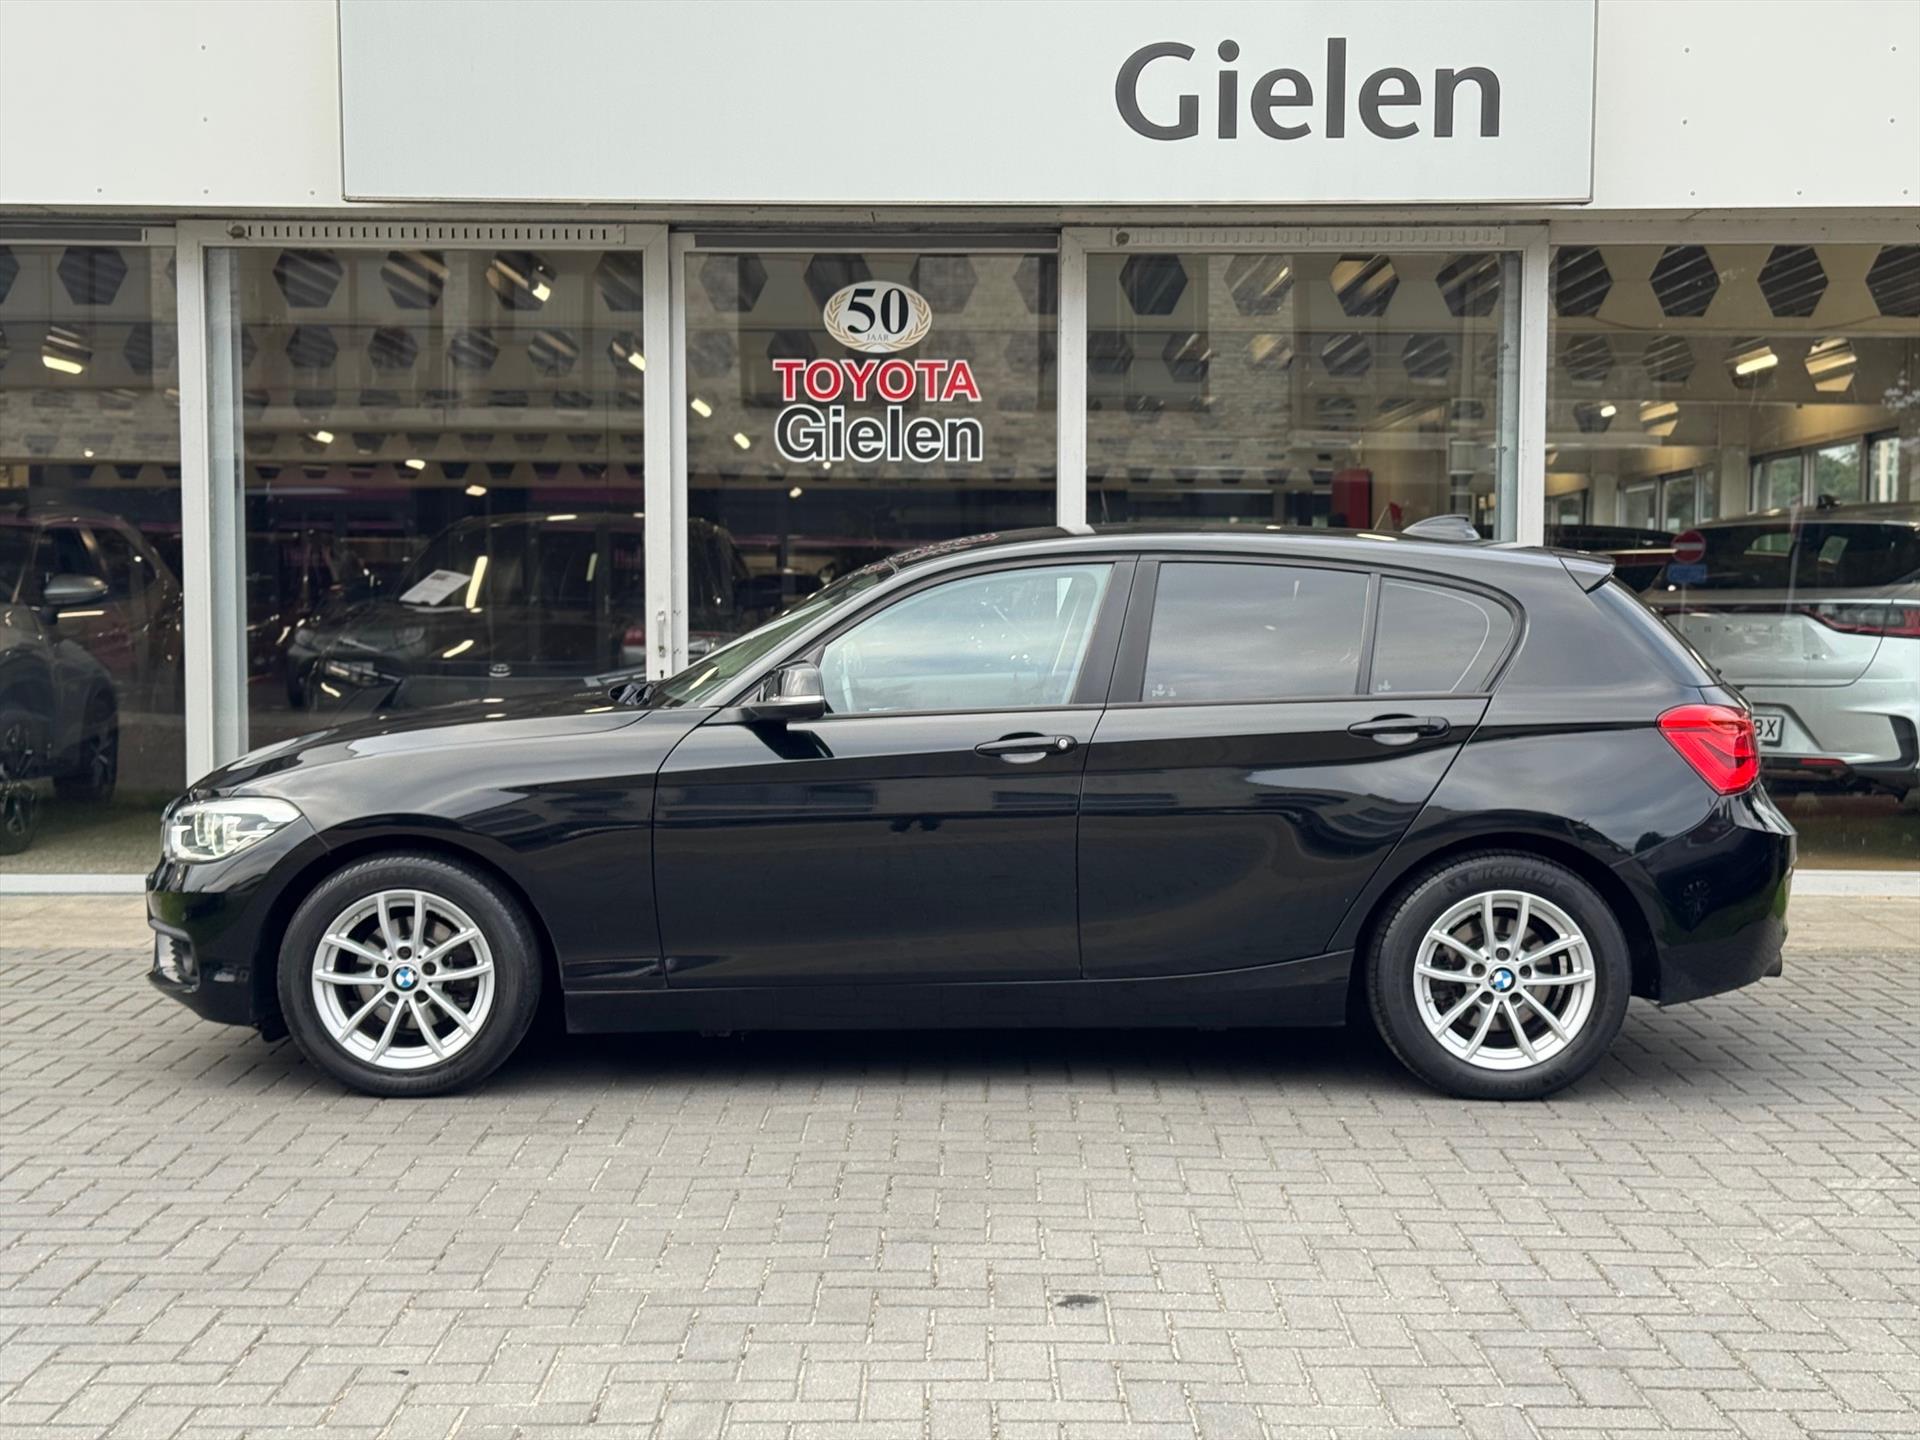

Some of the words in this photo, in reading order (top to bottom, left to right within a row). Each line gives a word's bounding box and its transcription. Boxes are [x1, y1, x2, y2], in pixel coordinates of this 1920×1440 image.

[1115, 37, 1501, 141] Gielen
[847, 287, 909, 335] 50
[866, 333, 889, 342] JAAR
[772, 358, 982, 402] TOYOTA
[774, 403, 983, 463] Gielen
[1468, 865, 1557, 887] MICHELIN
